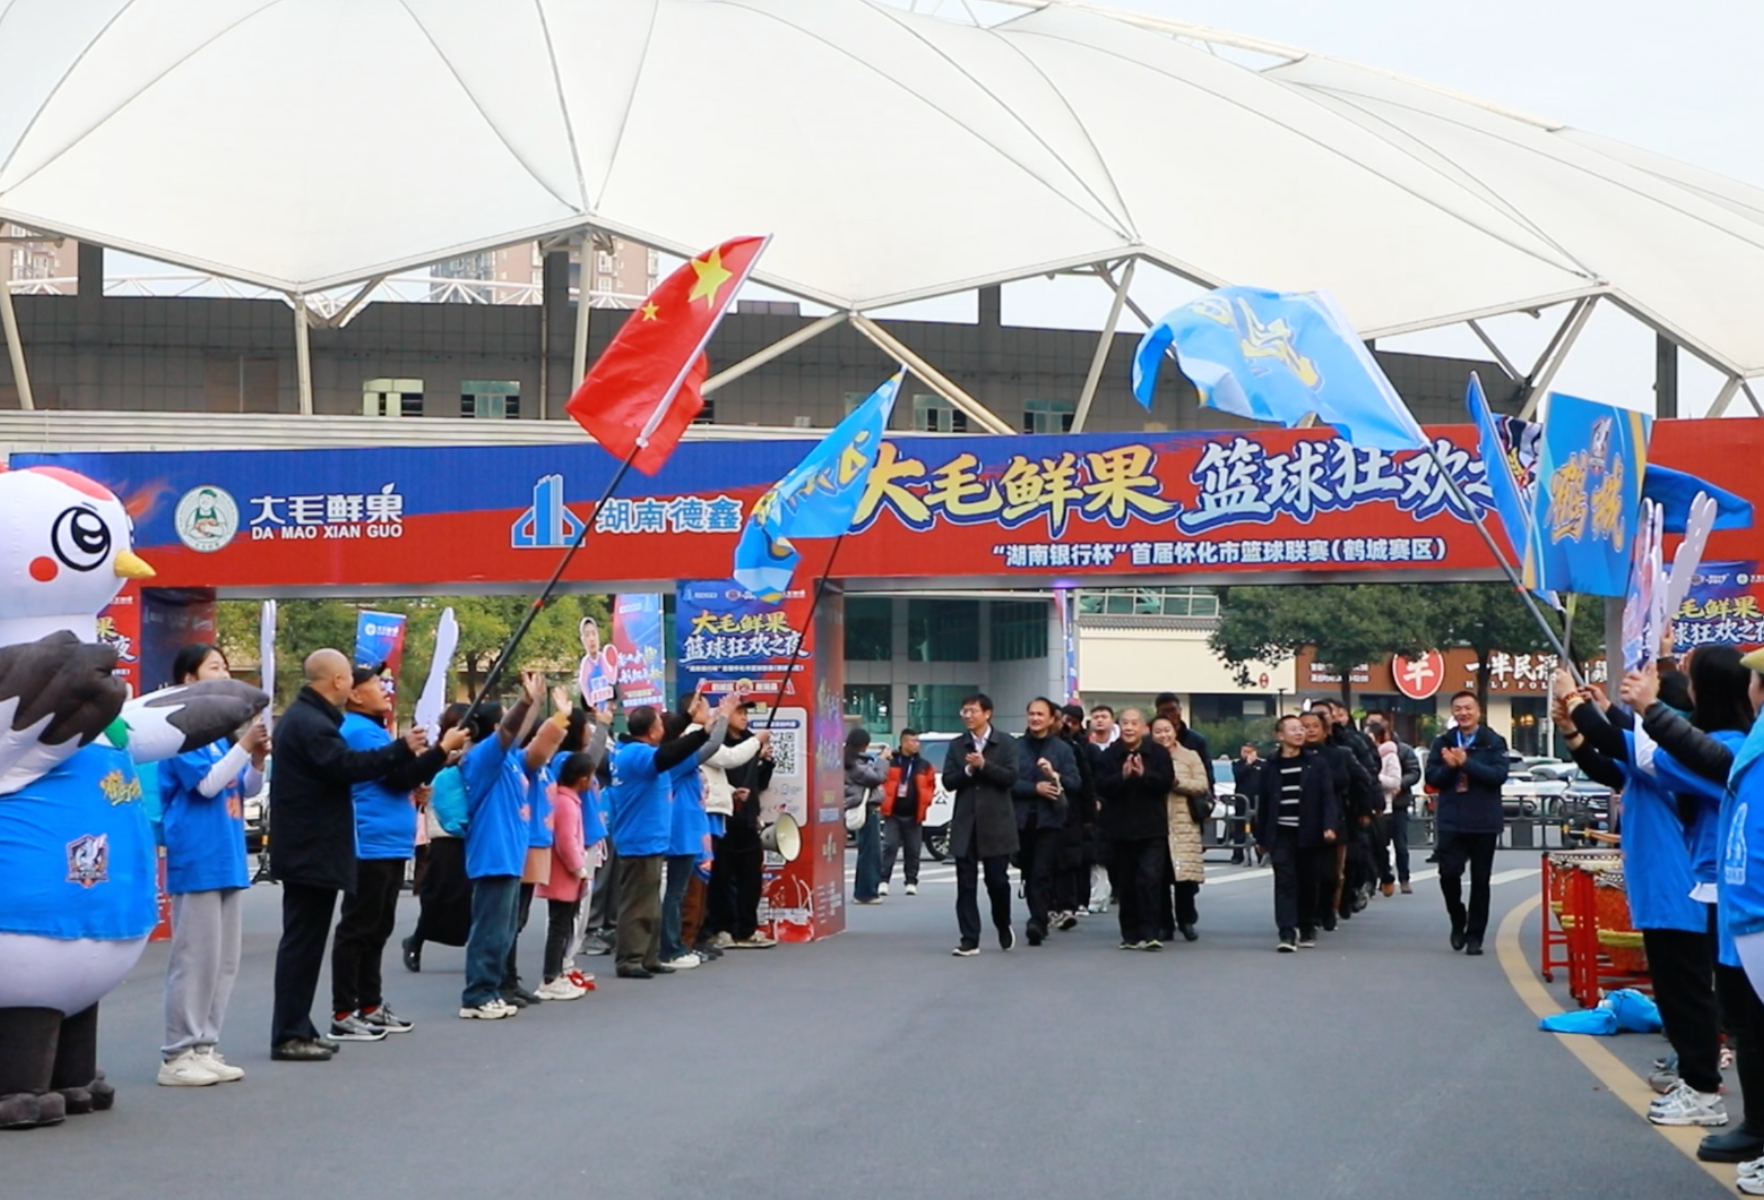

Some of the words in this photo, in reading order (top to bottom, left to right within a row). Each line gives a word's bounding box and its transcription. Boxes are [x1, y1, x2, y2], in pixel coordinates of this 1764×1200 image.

[850, 441, 1180, 536] 大毛鲜果
[249, 490, 403, 525] 大毛鲜果
[595, 494, 743, 534] 湖南德鑫
[252, 526, 273, 540] DA
[281, 526, 317, 540] MAO
[323, 525, 361, 539] XIAN
[367, 524, 402, 538] GUO
[1671, 595, 1763, 620] 毛鲜果
[691, 609, 791, 637] 大毛鲜果
[679, 632, 811, 664] 篮球狂欢之夜
[1466, 681, 1509, 689] HLF
